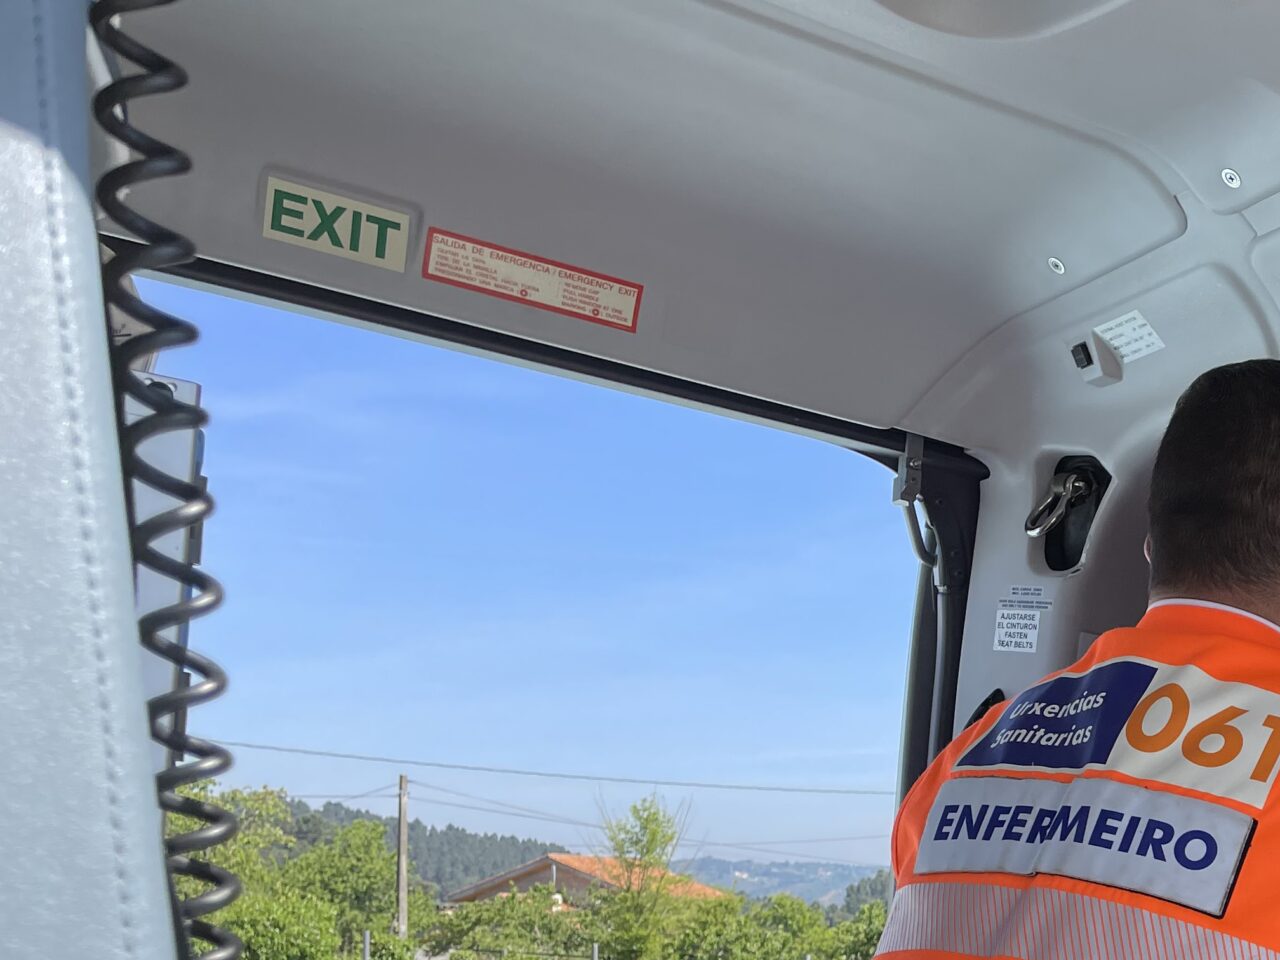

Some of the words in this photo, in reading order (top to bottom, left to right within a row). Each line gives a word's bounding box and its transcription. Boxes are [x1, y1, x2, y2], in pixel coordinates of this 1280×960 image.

[270, 188, 401, 259] EXIT
[432, 235, 467, 251] SALIDA
[472, 247, 484, 256] DE
[490, 251, 551, 274] EMERGENCIA
[558, 270, 614, 291] EMERGENCY
[618, 286, 637, 298] EXIT
[997, 621, 1005, 629] EL
[1006, 622, 1037, 630] CINTURON
[1001, 613, 1036, 621] AJUSTARSE
[1005, 631, 1028, 639] FASTEN
[1013, 640, 1033, 649] BELTS
[1009, 690, 1107, 720] Urxencias
[990, 724, 1093, 749] Sanitarias
[932, 804, 1218, 872] ENFERMEIRO
